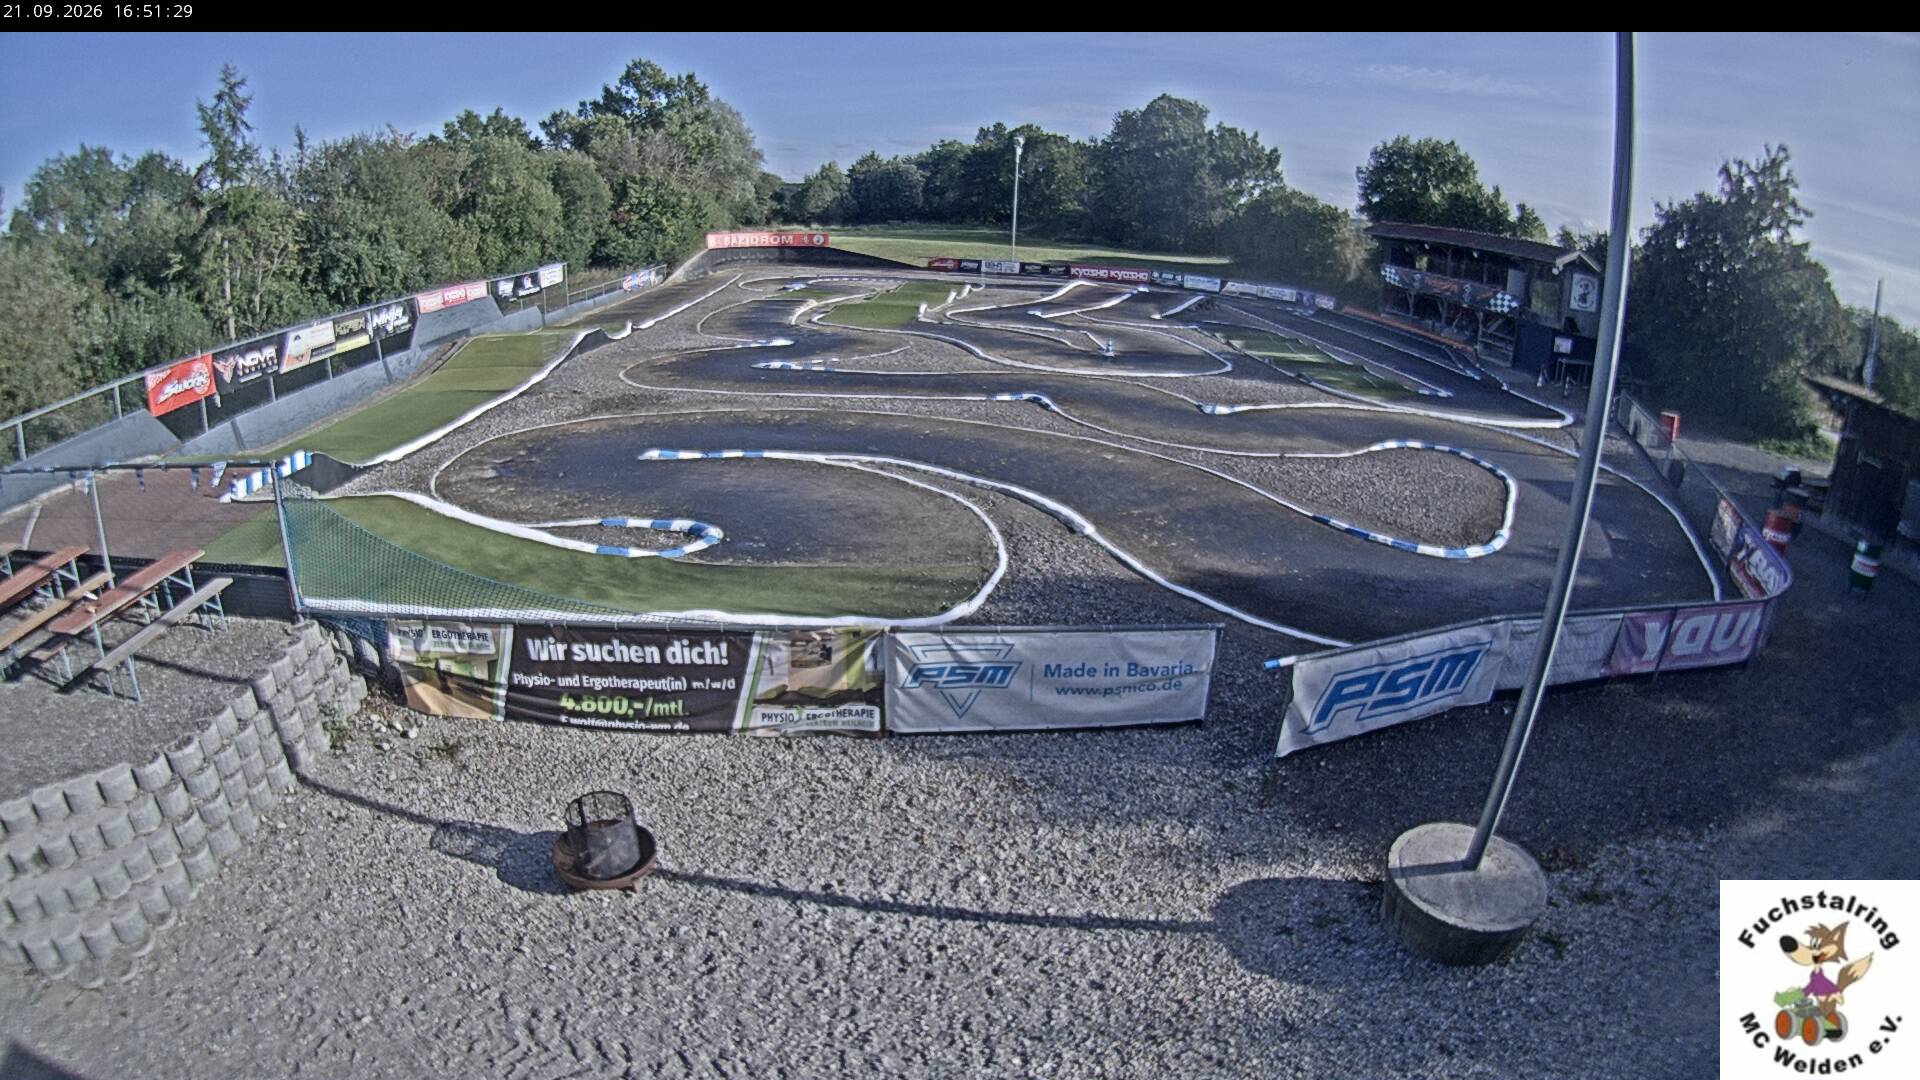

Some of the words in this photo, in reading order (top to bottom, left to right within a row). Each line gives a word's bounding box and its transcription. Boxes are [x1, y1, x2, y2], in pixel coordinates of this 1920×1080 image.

[526, 638, 567, 662] Wir
[573, 639, 660, 664] suchen
[666, 638, 728, 665] dich!
[908, 664, 1013, 686] PSM
[1043, 662, 1097, 678] Made
[1103, 662, 1119, 677] in
[513, 673, 556, 690] Physio-
[558, 674, 580, 688] und
[582, 675, 687, 693] Ergotherapeut(in)
[692, 678, 736, 691] m/w/d
[1055, 678, 1183, 698] www.psmco.de
[1315, 649, 1482, 724] PSM
[761, 712, 795, 723] PHYSIO
